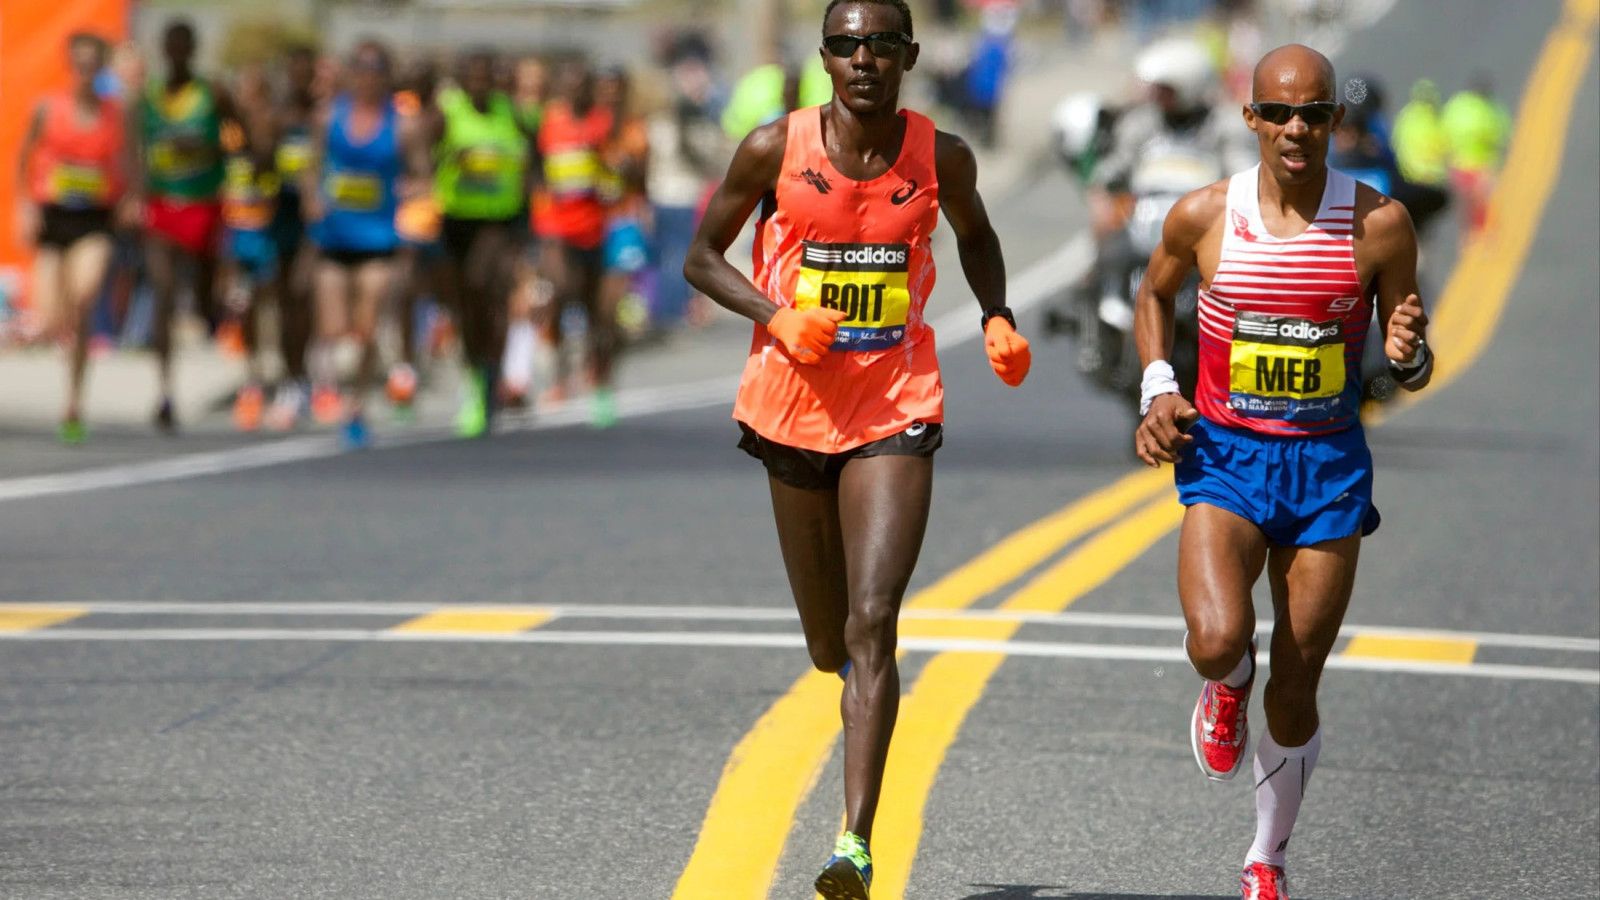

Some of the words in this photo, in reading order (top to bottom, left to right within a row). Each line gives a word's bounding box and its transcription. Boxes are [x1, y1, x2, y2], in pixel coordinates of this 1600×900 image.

[844, 247, 906, 264] adidas
[820, 283, 886, 322] BOIT
[1256, 355, 1322, 394] MEB
